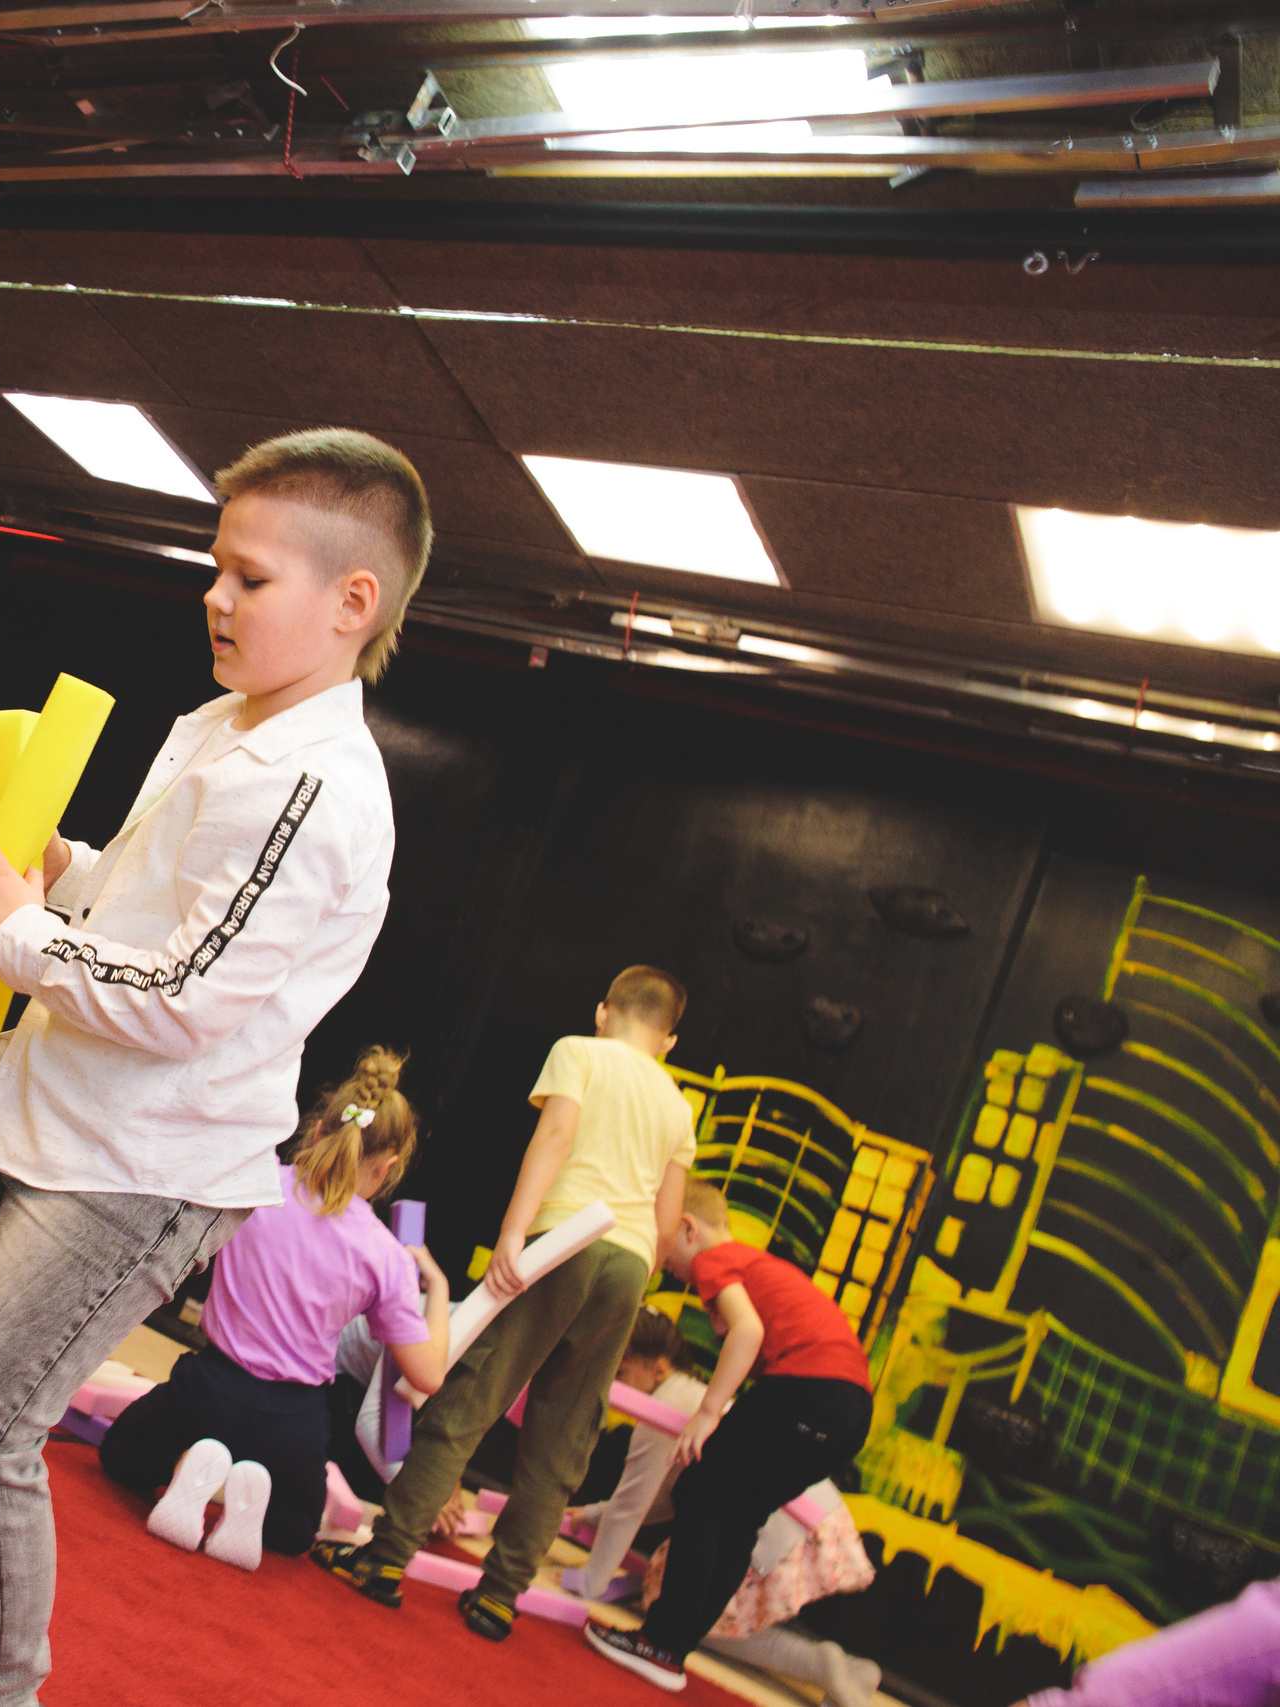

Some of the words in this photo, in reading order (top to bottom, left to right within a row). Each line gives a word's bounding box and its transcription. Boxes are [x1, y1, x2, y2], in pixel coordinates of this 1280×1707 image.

[256, 821, 292, 883] #URBAN
[220, 881, 260, 937] #URBAN
[190, 933, 222, 976] #URBA
